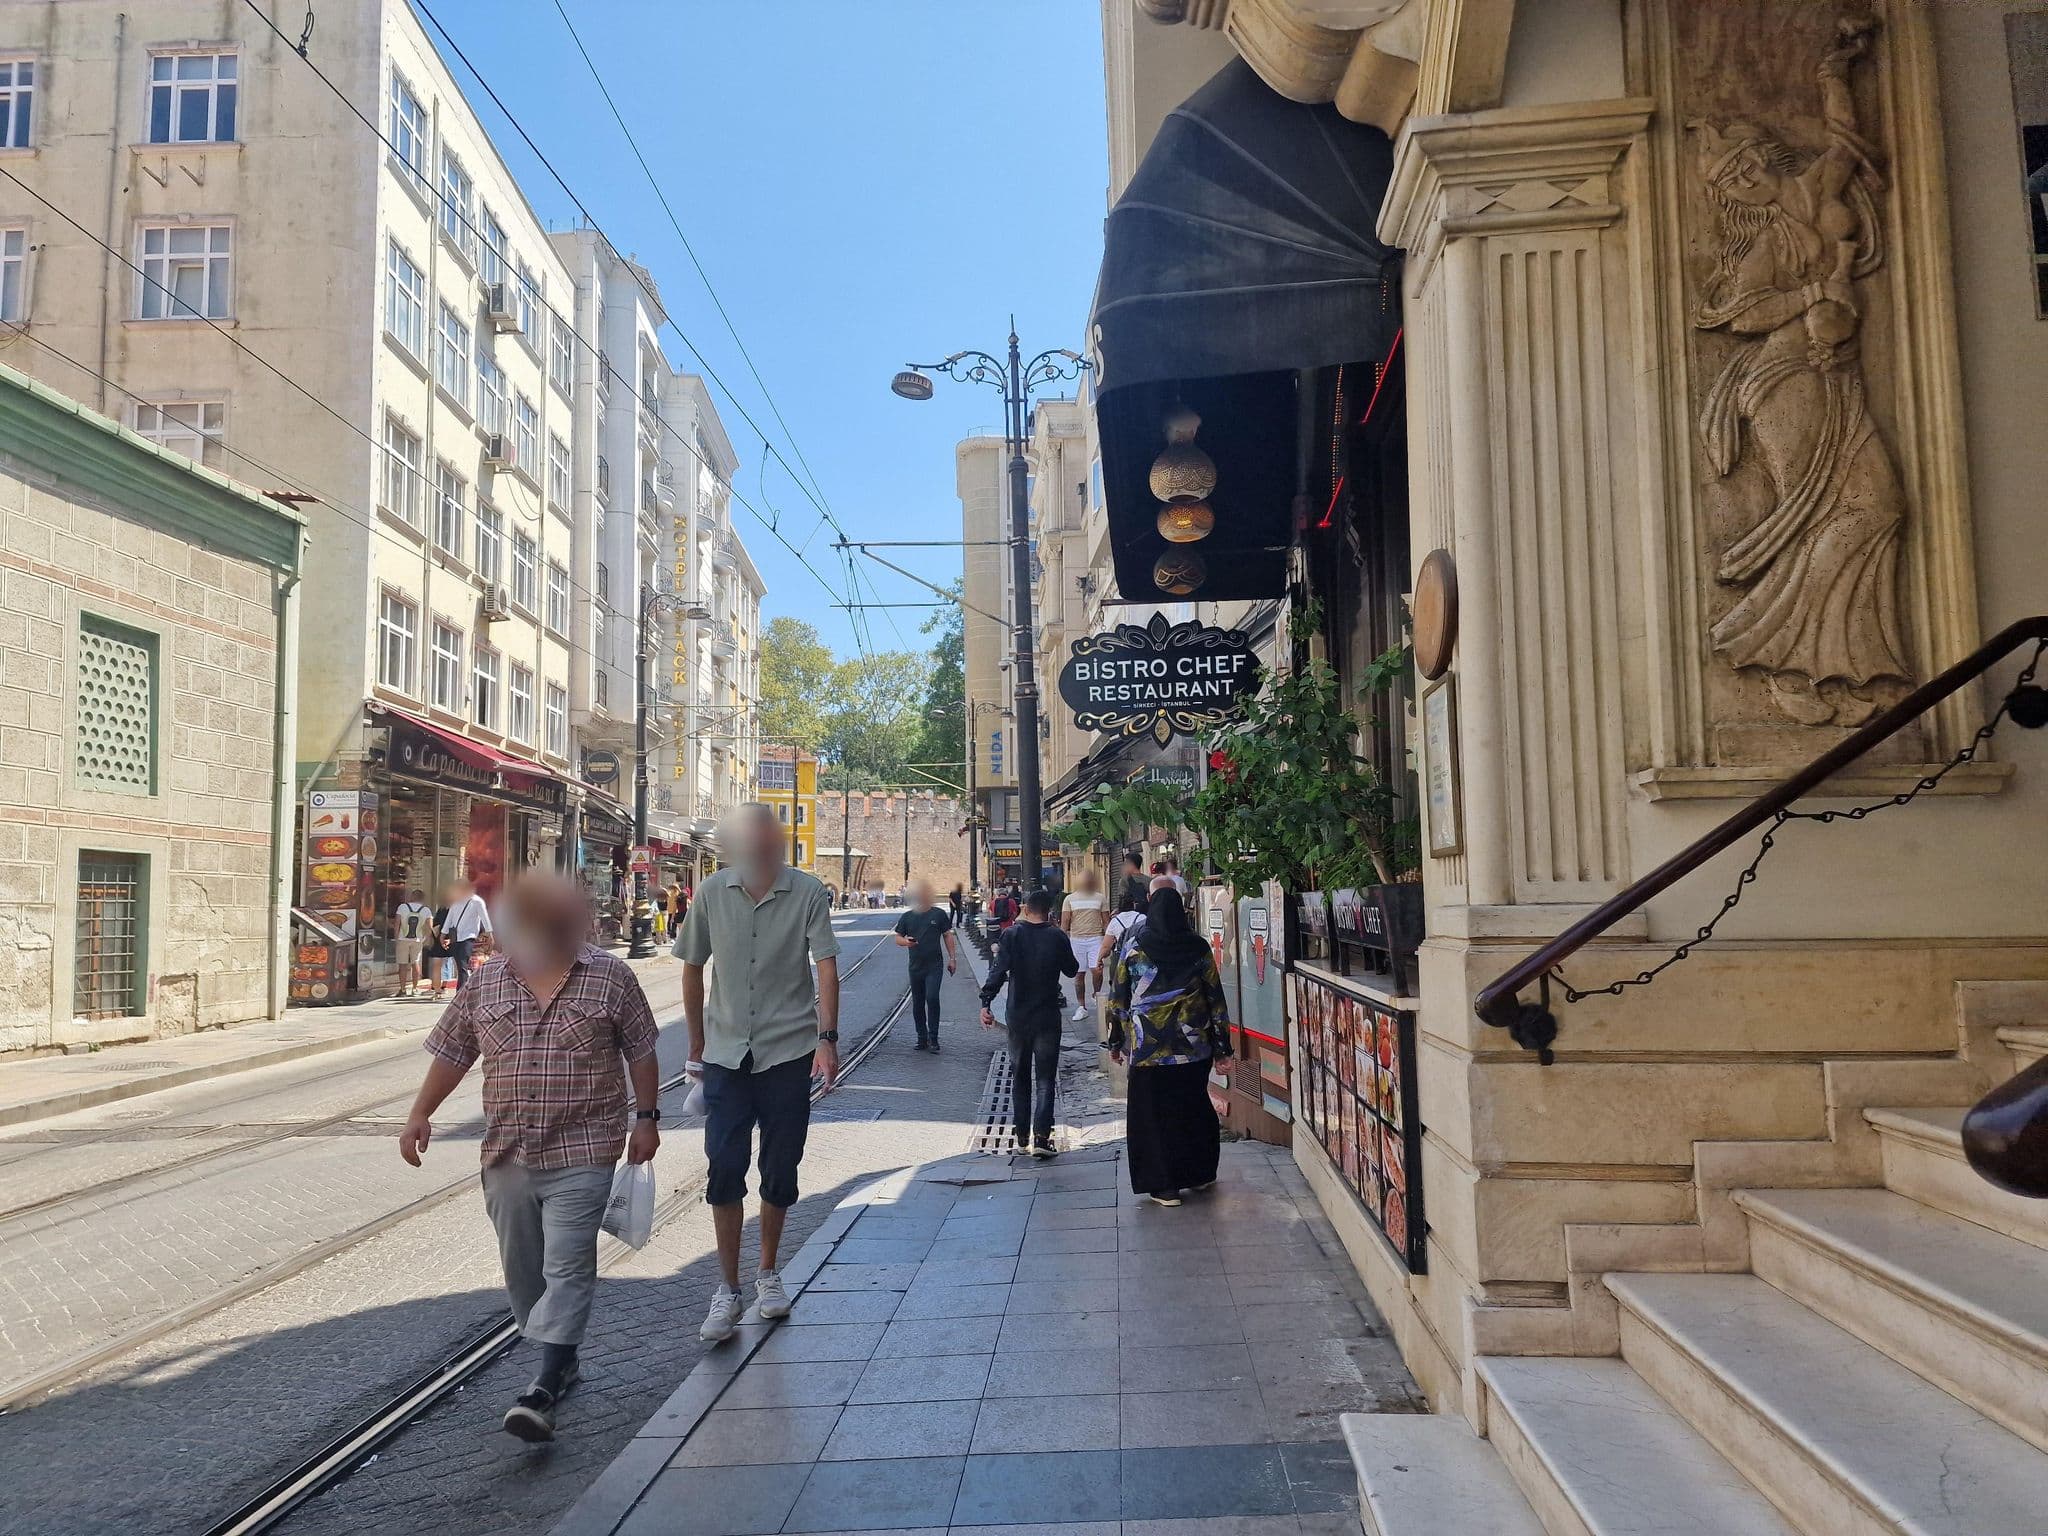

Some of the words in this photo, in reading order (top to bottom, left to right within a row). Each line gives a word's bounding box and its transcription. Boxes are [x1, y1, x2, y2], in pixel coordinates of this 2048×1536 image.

[673, 514, 687, 592] HOTEL
[673, 608, 687, 685] BLACK
[1176, 654, 1247, 677] CHEF
[1089, 679, 1234, 702] RESTAURANT
[991, 731, 1002, 774] NEDA
[996, 849, 1017, 857] NEDA
[1362, 906, 1382, 935] CHEF
